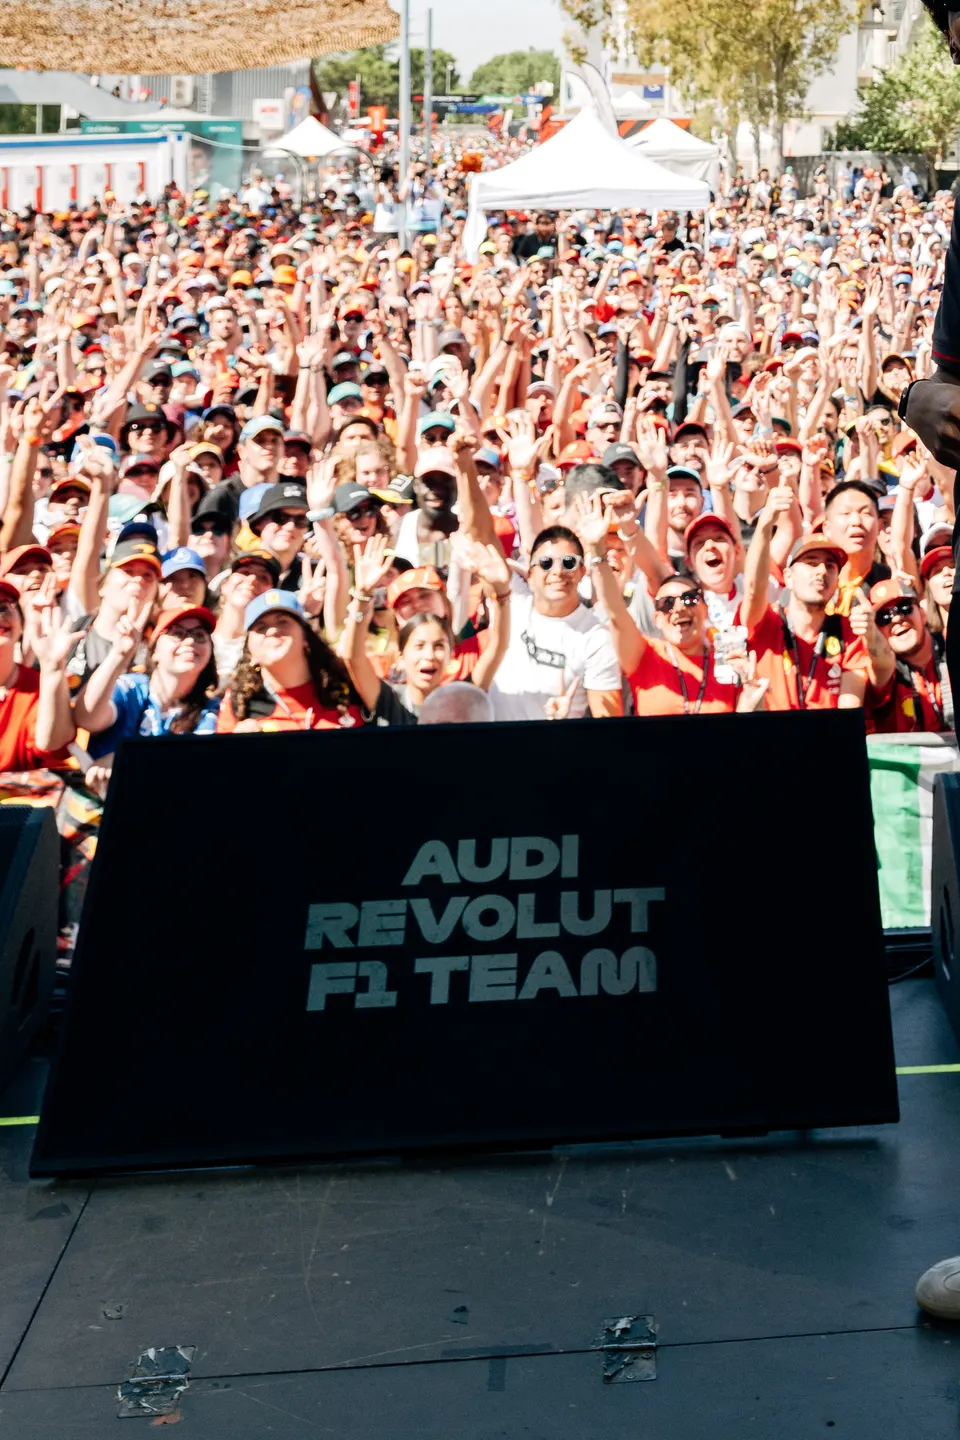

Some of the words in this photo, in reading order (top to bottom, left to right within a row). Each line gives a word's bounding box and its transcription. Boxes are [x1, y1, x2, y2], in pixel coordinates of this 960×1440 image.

[401, 834, 579, 886] AUDI
[304, 887, 666, 950] REVOLUT
[306, 959, 398, 1011] F1
[414, 946, 657, 1005] TEAM
